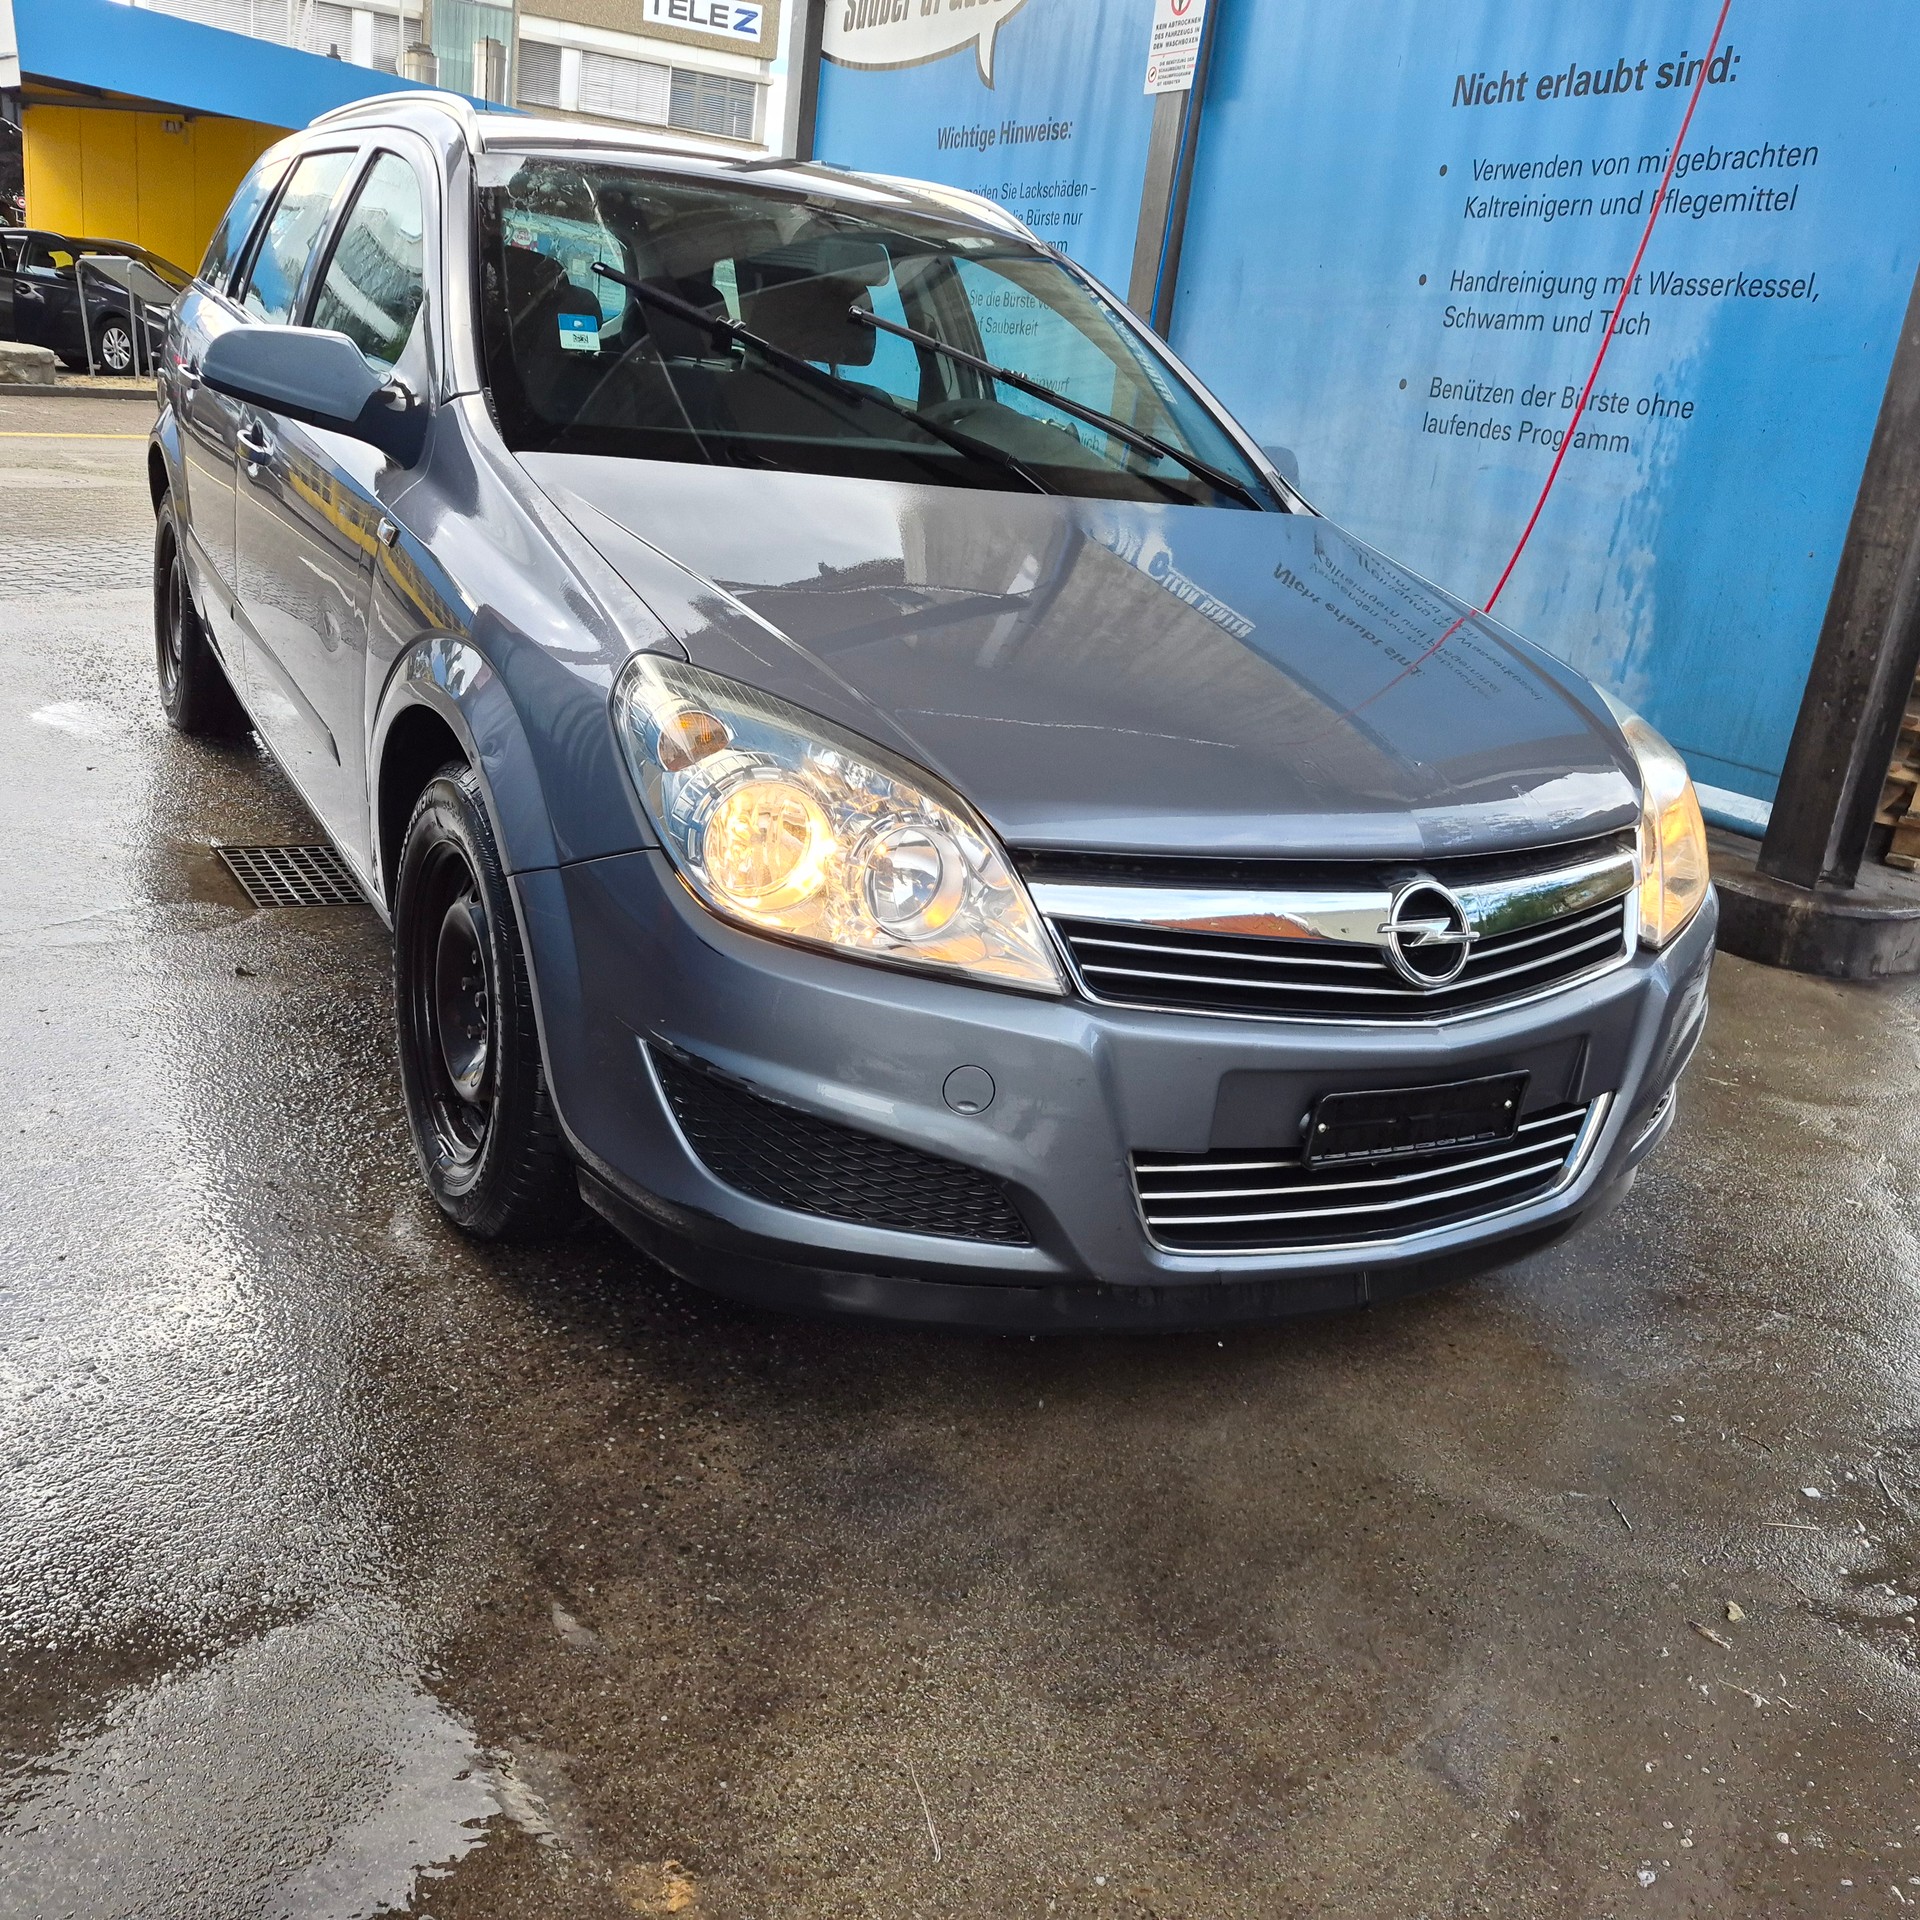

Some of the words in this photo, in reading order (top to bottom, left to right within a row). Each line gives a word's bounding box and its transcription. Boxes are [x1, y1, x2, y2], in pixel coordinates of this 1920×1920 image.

[1154, 32, 1164, 40] DES
[1155, 23, 1167, 31] KEIN
[1452, 70, 1529, 107] Nicht
[1536, 58, 1648, 100] erlaubt
[1655, 46, 1741, 89] sind:
[938, 124, 996, 152] Wichtige
[1000, 117, 1073, 145] Hinweise:
[1473, 155, 1583, 181] Verwenden
[1592, 156, 1630, 176] von
[1637, 142, 1819, 178] migebrachten
[1001, 183, 1017, 200] Sie
[1020, 179, 1088, 199] Lackschäden
[1026, 209, 1059, 226] Bürste
[1063, 212, 1084, 225] nur
[1463, 193, 1593, 222] Kaltreinigern
[1600, 190, 1643, 215] und
[986, 290, 1000, 308] die
[1003, 291, 1035, 309] Bürste
[1450, 269, 1597, 300] Handreinigung
[1650, 271, 1820, 303] Wasserkessel,
[985, 316, 1038, 337] Sauberkeit
[1443, 305, 1545, 332] Schwamm
[1552, 310, 1593, 334] und
[1600, 309, 1651, 336] Tuch
[1430, 376, 1514, 404] Benützen
[1521, 384, 1556, 408] der
[1636, 392, 1695, 420] ohne
[1422, 411, 1512, 441] laufendes
